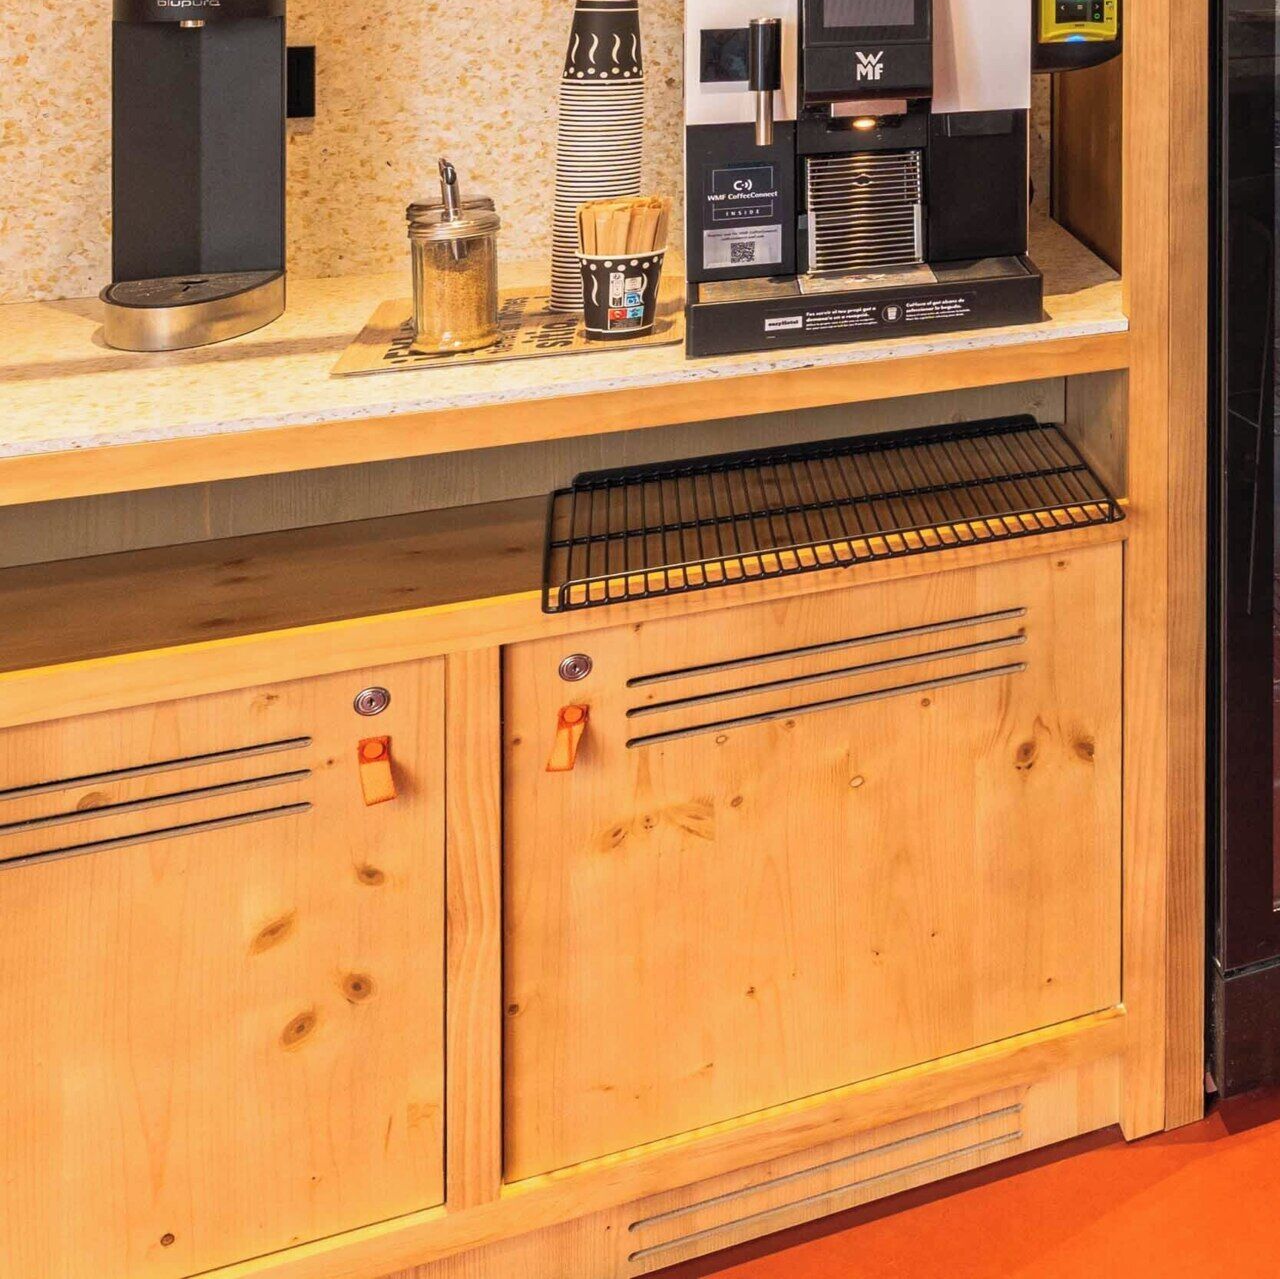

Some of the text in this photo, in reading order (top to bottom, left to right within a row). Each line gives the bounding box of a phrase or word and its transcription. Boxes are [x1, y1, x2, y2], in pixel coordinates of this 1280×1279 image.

[157, 0, 221, 8] blupura
[707, 193, 726, 201] WMF
[725, 208, 761, 217] INSIDE
